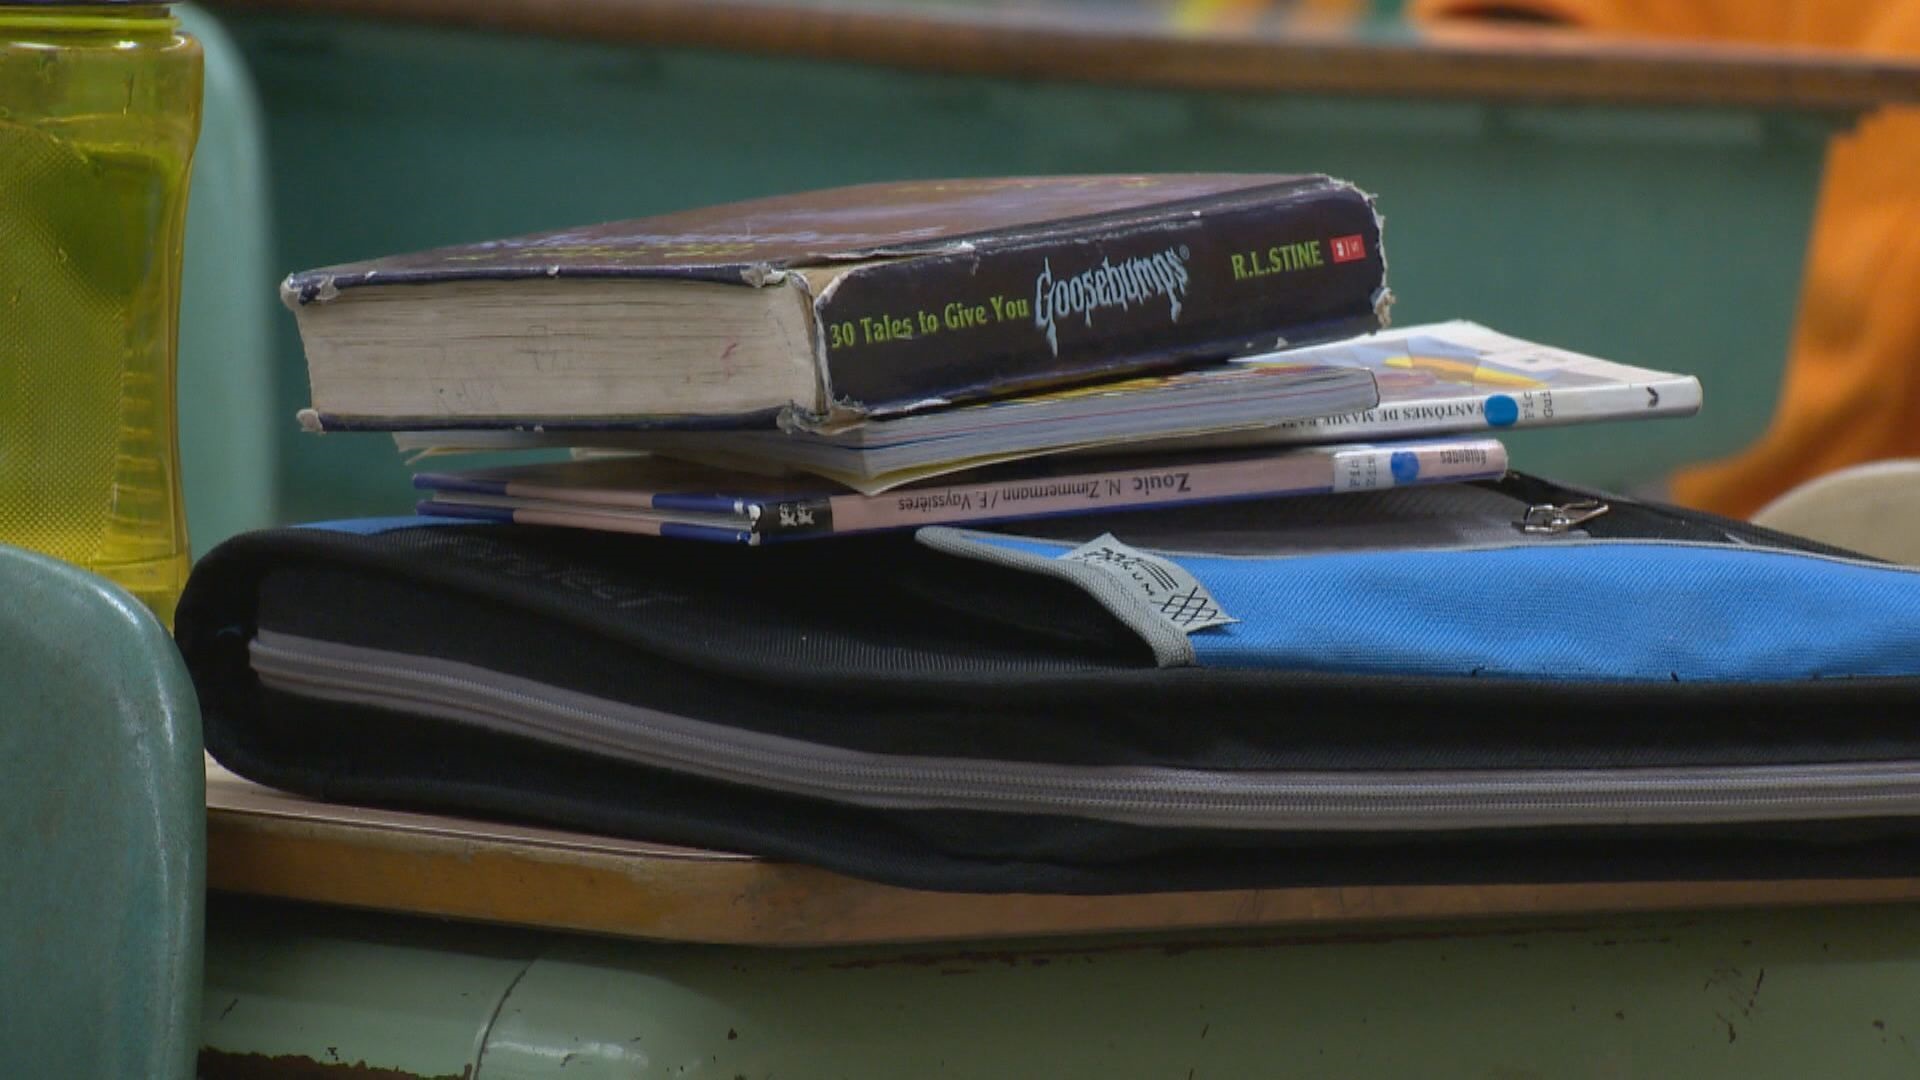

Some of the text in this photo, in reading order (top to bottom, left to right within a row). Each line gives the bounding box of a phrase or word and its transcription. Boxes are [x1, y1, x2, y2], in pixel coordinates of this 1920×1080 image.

[1230, 240, 1324, 281] R.L.STINE
[830, 246, 1190, 357] 30 Tales to Give You Goosebumps
[1383, 406, 1399, 422] DE
[1002, 479, 1100, 502] Zimmermann
[1108, 478, 1121, 496] N.
[1133, 472, 1192, 493] Zouic
[898, 493, 972, 511] Vayssières
